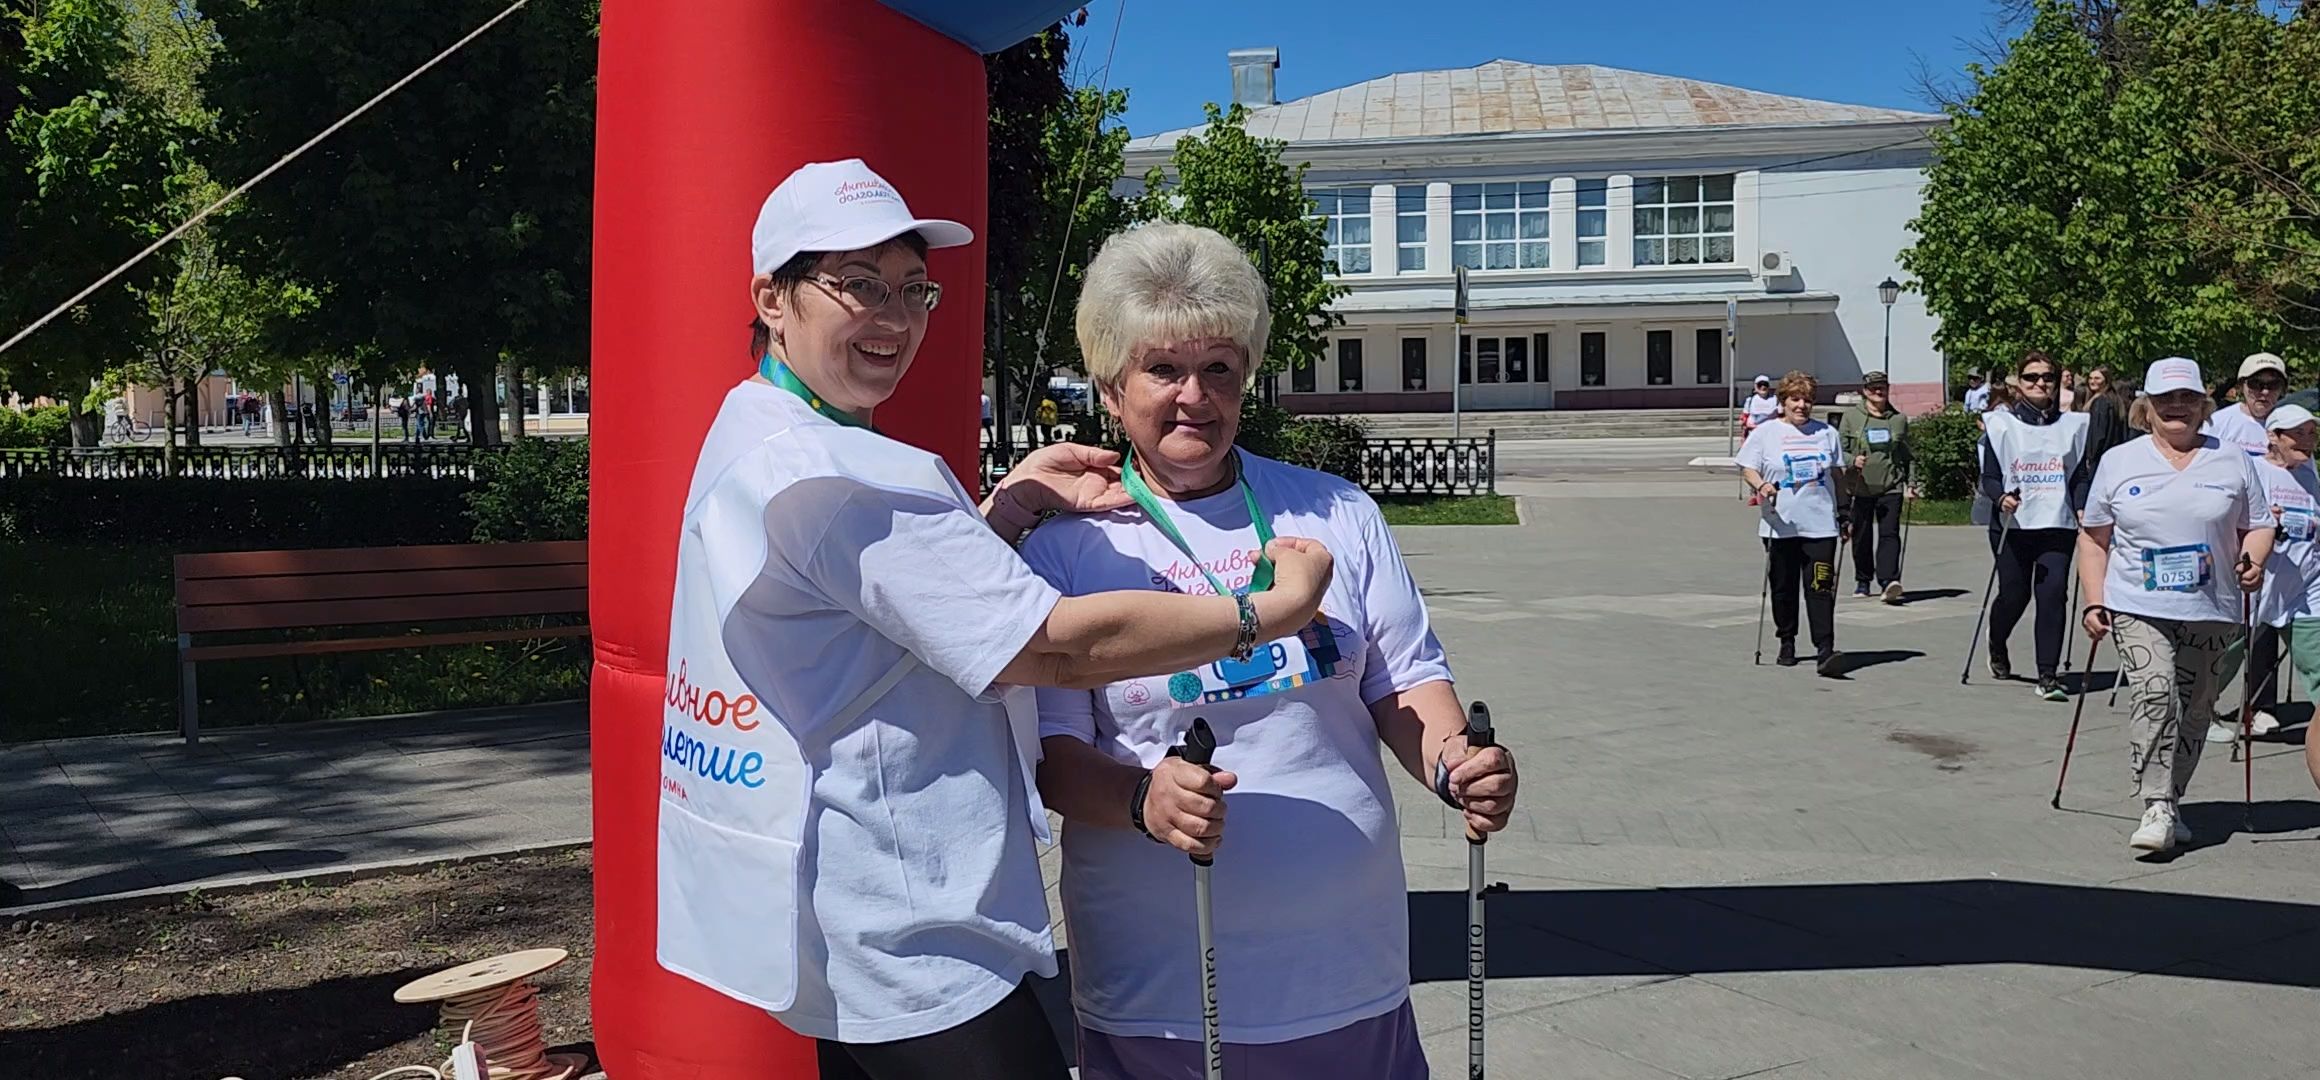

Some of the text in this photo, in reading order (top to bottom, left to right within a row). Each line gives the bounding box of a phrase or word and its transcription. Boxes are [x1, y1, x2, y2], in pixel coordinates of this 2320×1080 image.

[2161, 570, 2194, 584] 0753
[664, 657, 761, 731] ивное
[661, 723, 767, 789] летие
